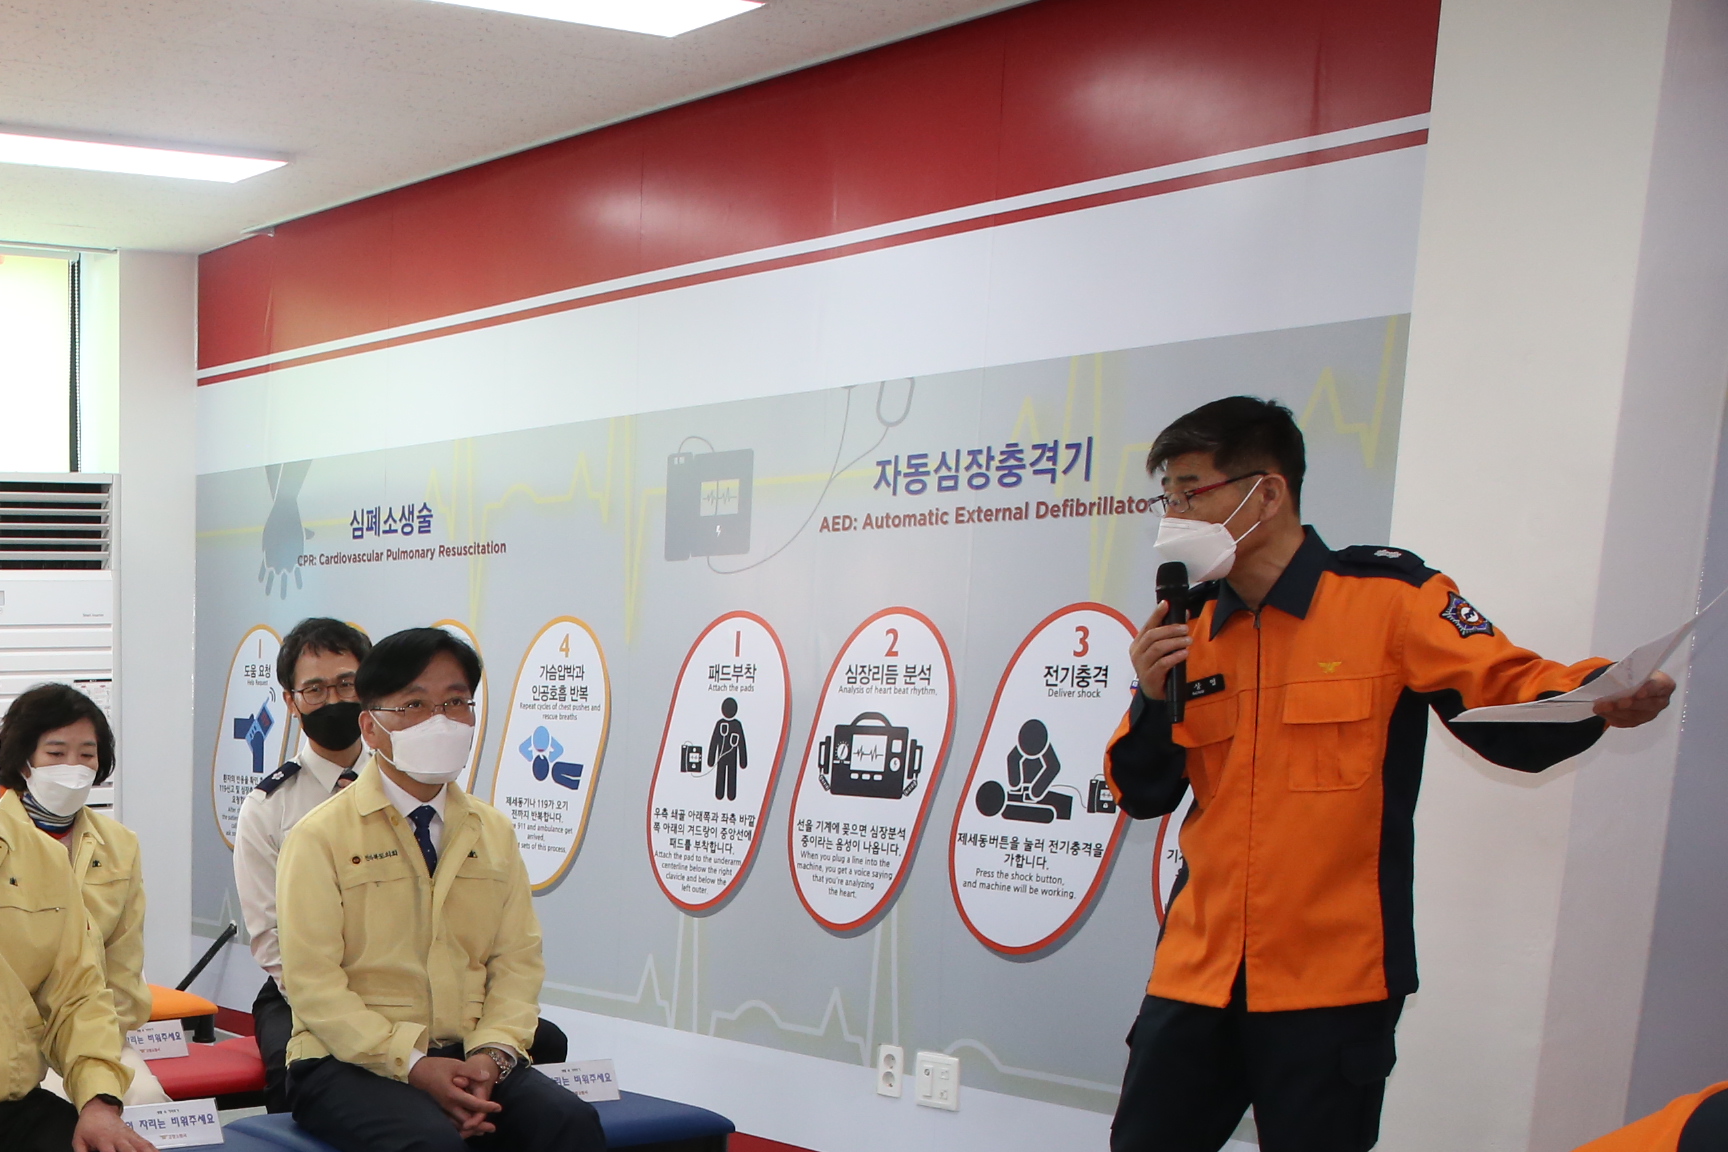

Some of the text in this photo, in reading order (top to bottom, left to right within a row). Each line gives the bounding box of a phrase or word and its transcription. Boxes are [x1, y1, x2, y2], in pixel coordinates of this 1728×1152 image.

[873, 436, 1093, 496] 자동심장충격기
[350, 502, 433, 539] 심폐소생술
[819, 515, 857, 533] AED:
[862, 508, 948, 530] Automatic
[955, 502, 1029, 524] External
[297, 540, 507, 567] CPR: Cardiovascular Pulmonary Resuscitation
[559, 633, 569, 658] 4
[885, 628, 898, 657] 2
[1073, 626, 1089, 657] 3
[244, 664, 271, 678] 도움 요청
[540, 664, 585, 681] 가슴압박과
[708, 664, 757, 683] 패드부착
[845, 664, 931, 685] 심장리듬 분석
[1043, 665, 1108, 688] 전기충격
[532, 685, 588, 702] 인공호흡 반복
[740, 684, 754, 692] pads
[838, 686, 908, 694] Analysis heart beat
[1048, 689, 1101, 698] Deliver shock
[537, 703, 551, 711] cycles
[538, 799, 568, 811] 119가 오기
[512, 809, 529, 819] 전까지
[654, 808, 755, 827] 우측 쇄골 아래쪽과 좌측 바깥
[537, 825, 563, 833] ambulance
[663, 823, 752, 841] 아래의 겨드랑이 중앙선에
[797, 819, 906, 840] 선을 기계에 꽂으면 심장분석
[670, 838, 734, 855] 패드를 부착합니다.
[801, 835, 901, 857] 중이라는 음성이 나옵니다.
[957, 833, 1104, 858] 제세동버튼을 눌러 전기충격을
[655, 850, 741, 865] Attach the pad the underarm
[801, 850, 818, 859] When
[832, 855, 845, 864] plug
[852, 856, 863, 864] line
[865, 858, 877, 866] into
[879, 859, 890, 867] the
[1004, 853, 1049, 870] 가합니다.
[662, 862, 688, 871] centerline
[690, 865, 706, 873] below
[719, 868, 732, 876] right
[838, 867, 847, 875] get
[854, 869, 870, 877] voice
[872, 871, 892, 880] saying
[976, 868, 1064, 886] Press the shock button,
[666, 873, 685, 881] clavicle
[698, 876, 715, 884] below
[845, 879, 874, 889] analyzing
[829, 887, 838, 895] the
[963, 880, 977, 888] and
[979, 883, 1011, 892] machine
[1041, 889, 1076, 899] working.
[148, 1032, 181, 1043] 비워주세요
[574, 1073, 612, 1084] 비워주세요
[140, 1114, 215, 1130] 자리는 비워주세요
